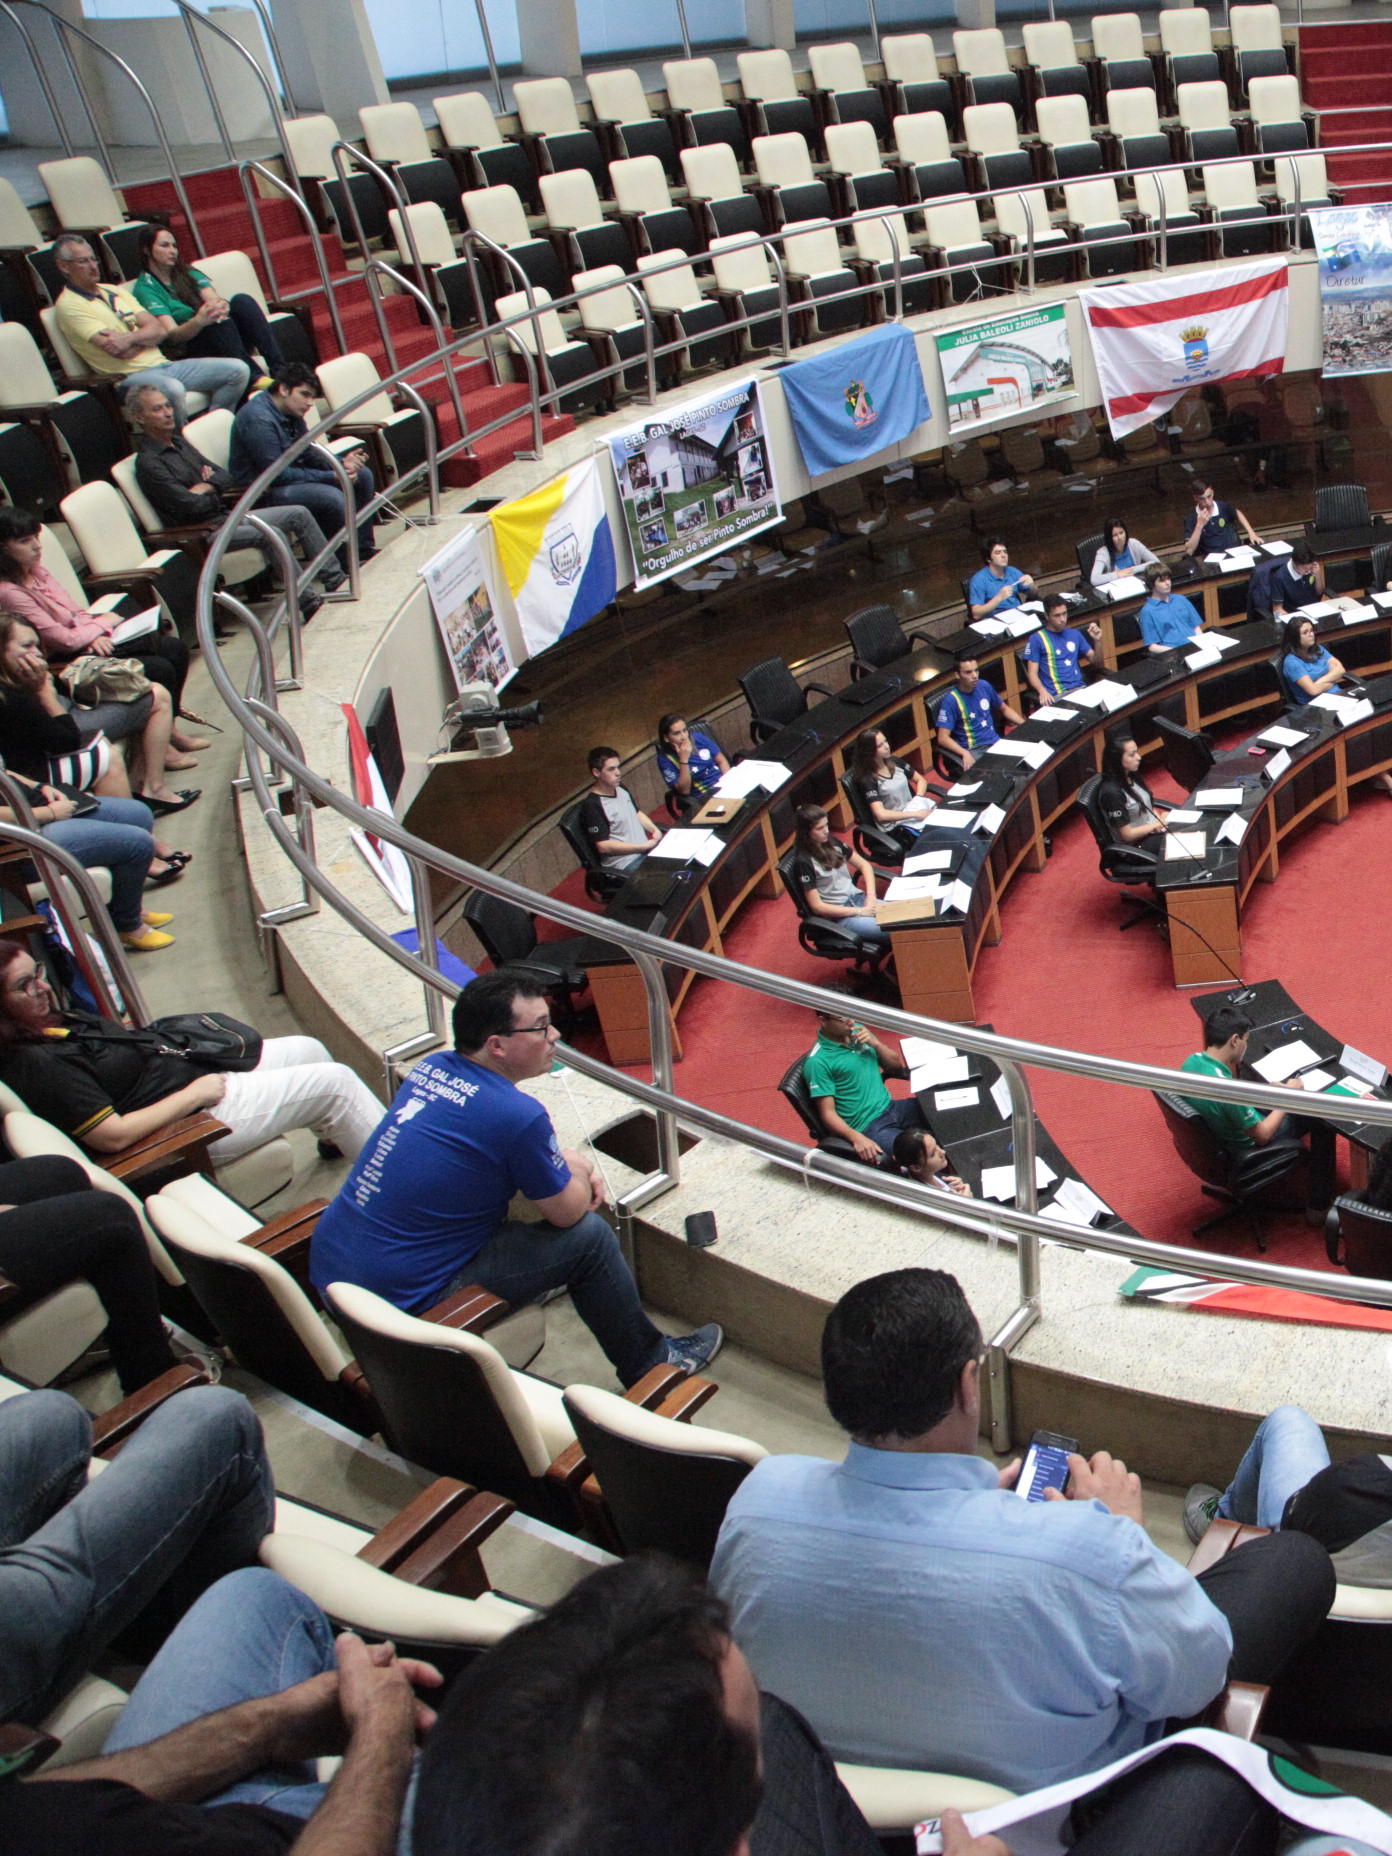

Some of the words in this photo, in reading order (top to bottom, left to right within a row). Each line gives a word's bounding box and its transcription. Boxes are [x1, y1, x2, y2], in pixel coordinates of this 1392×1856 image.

[1325, 275, 1367, 288] Diretur
[1015, 314, 1049, 330] ZANIOLO
[623, 431, 649, 449] E.E.B.
[670, 411, 691, 432] JOSÉ
[691, 405, 717, 424] PINTO
[717, 391, 750, 413] SOMBRA
[686, 540, 698, 553] de
[700, 535, 712, 548] ser
[713, 523, 735, 540] Pinto
[424, 1079, 467, 1107] SOMBRA
[431, 1068, 449, 1083] GAL
[447, 1076, 480, 1097] JOSÉ
